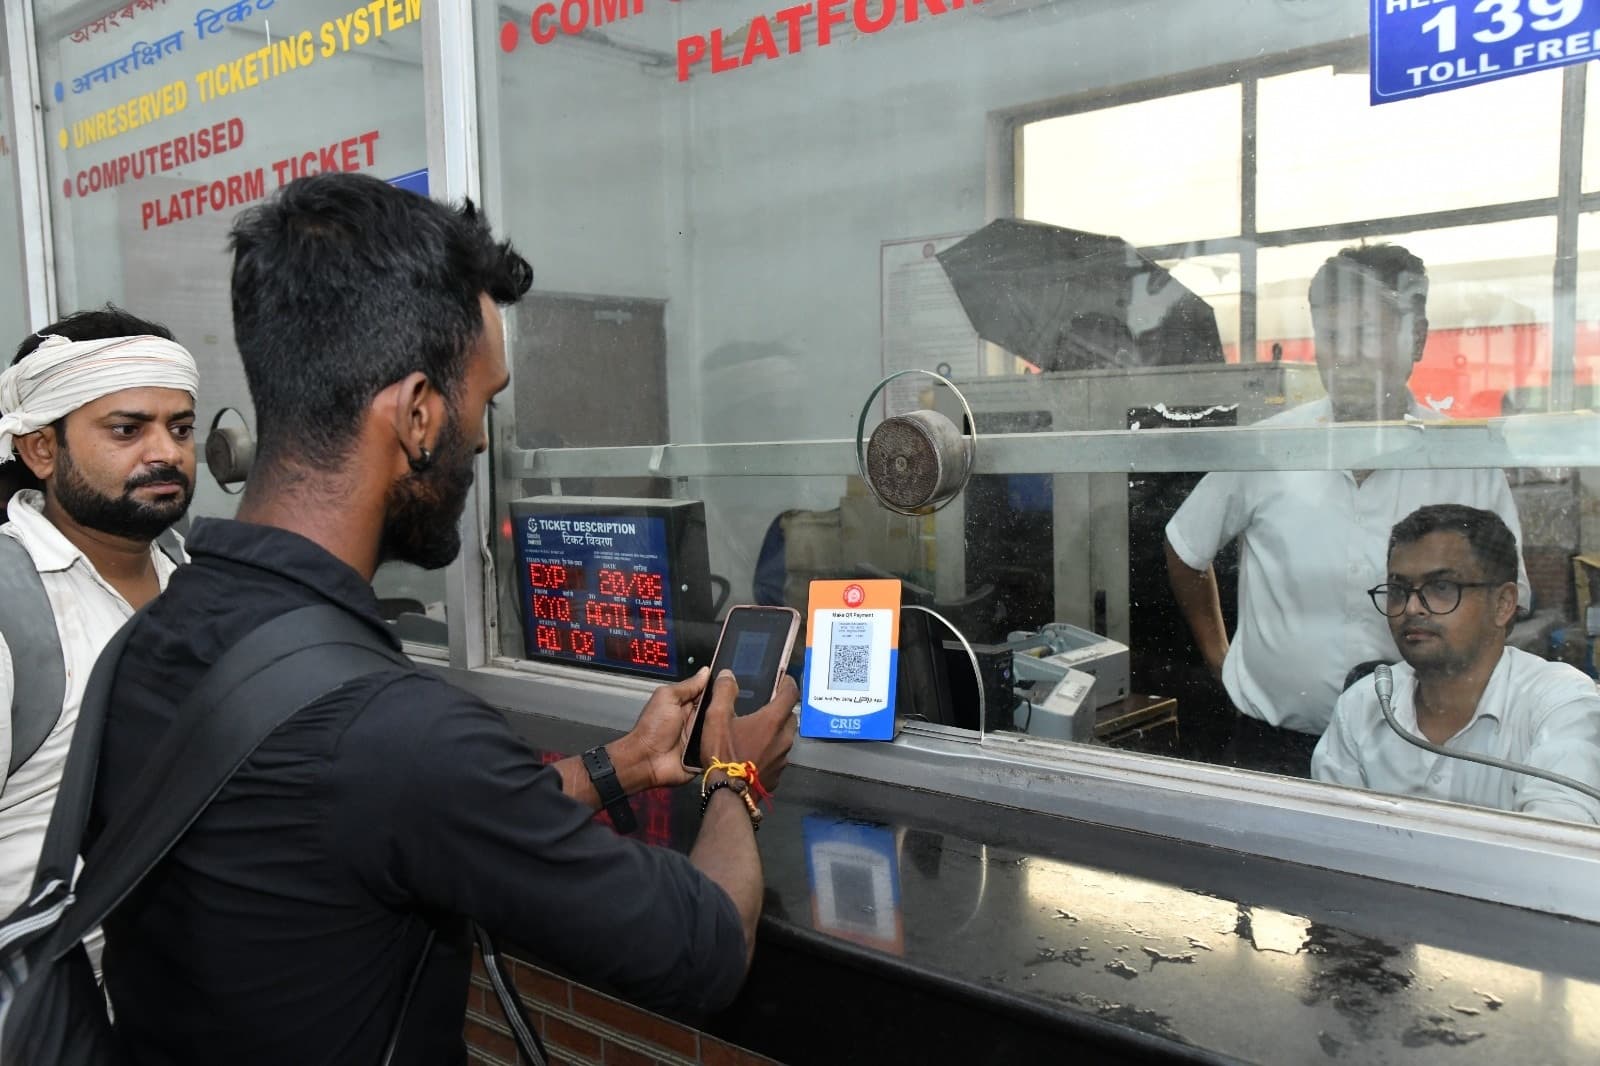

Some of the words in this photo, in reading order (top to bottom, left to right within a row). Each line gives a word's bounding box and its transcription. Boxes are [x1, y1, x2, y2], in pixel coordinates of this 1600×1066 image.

[71, 29, 184, 94] अनारक्षित
[1406, 53, 1501, 87] TOLL
[1513, 31, 1600, 67] FRE
[72, 79, 188, 150] UNRESERVED
[195, 30, 315, 104] TICKETING
[76, 117, 245, 198] COMPUTERISED
[141, 167, 265, 230] PLATFORM
[272, 130, 379, 191] TICKET
[539, 519, 572, 532] TICKET
[573, 521, 636, 535] DESCRIPTION
[561, 531, 584, 545] टिकट
[584, 532, 613, 548] विवरण
[530, 563, 567, 589] EXP
[830, 718, 862, 730] CRIS
